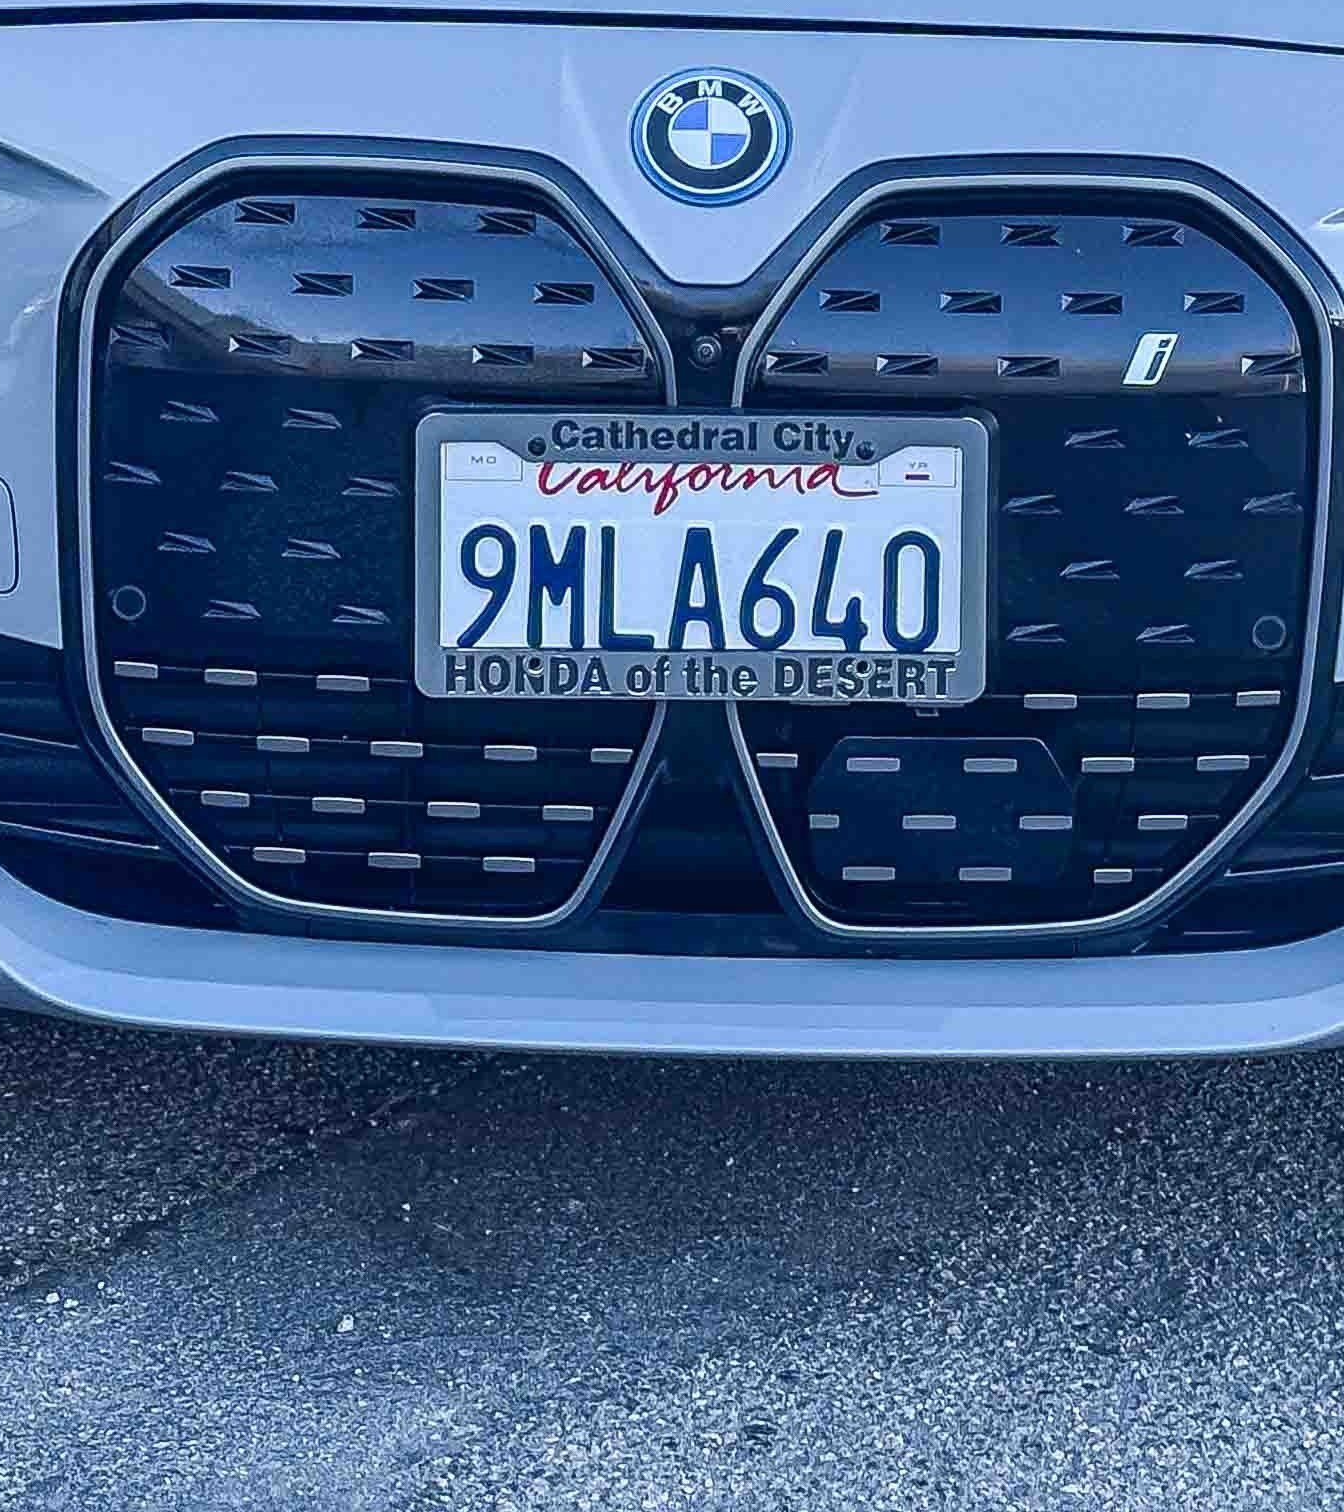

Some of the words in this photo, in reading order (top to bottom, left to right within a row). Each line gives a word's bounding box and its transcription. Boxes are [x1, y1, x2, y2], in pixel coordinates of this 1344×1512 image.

[656, 79, 765, 117] BMW
[471, 455, 497, 464] MO
[551, 419, 757, 455] Cathedral
[773, 420, 856, 459] City
[537, 462, 879, 515] California
[456, 522, 942, 653] 9MLA640
[445, 654, 610, 696] HONDA
[626, 656, 679, 697] of
[686, 656, 758, 698] the
[774, 656, 956, 700] DESERT
